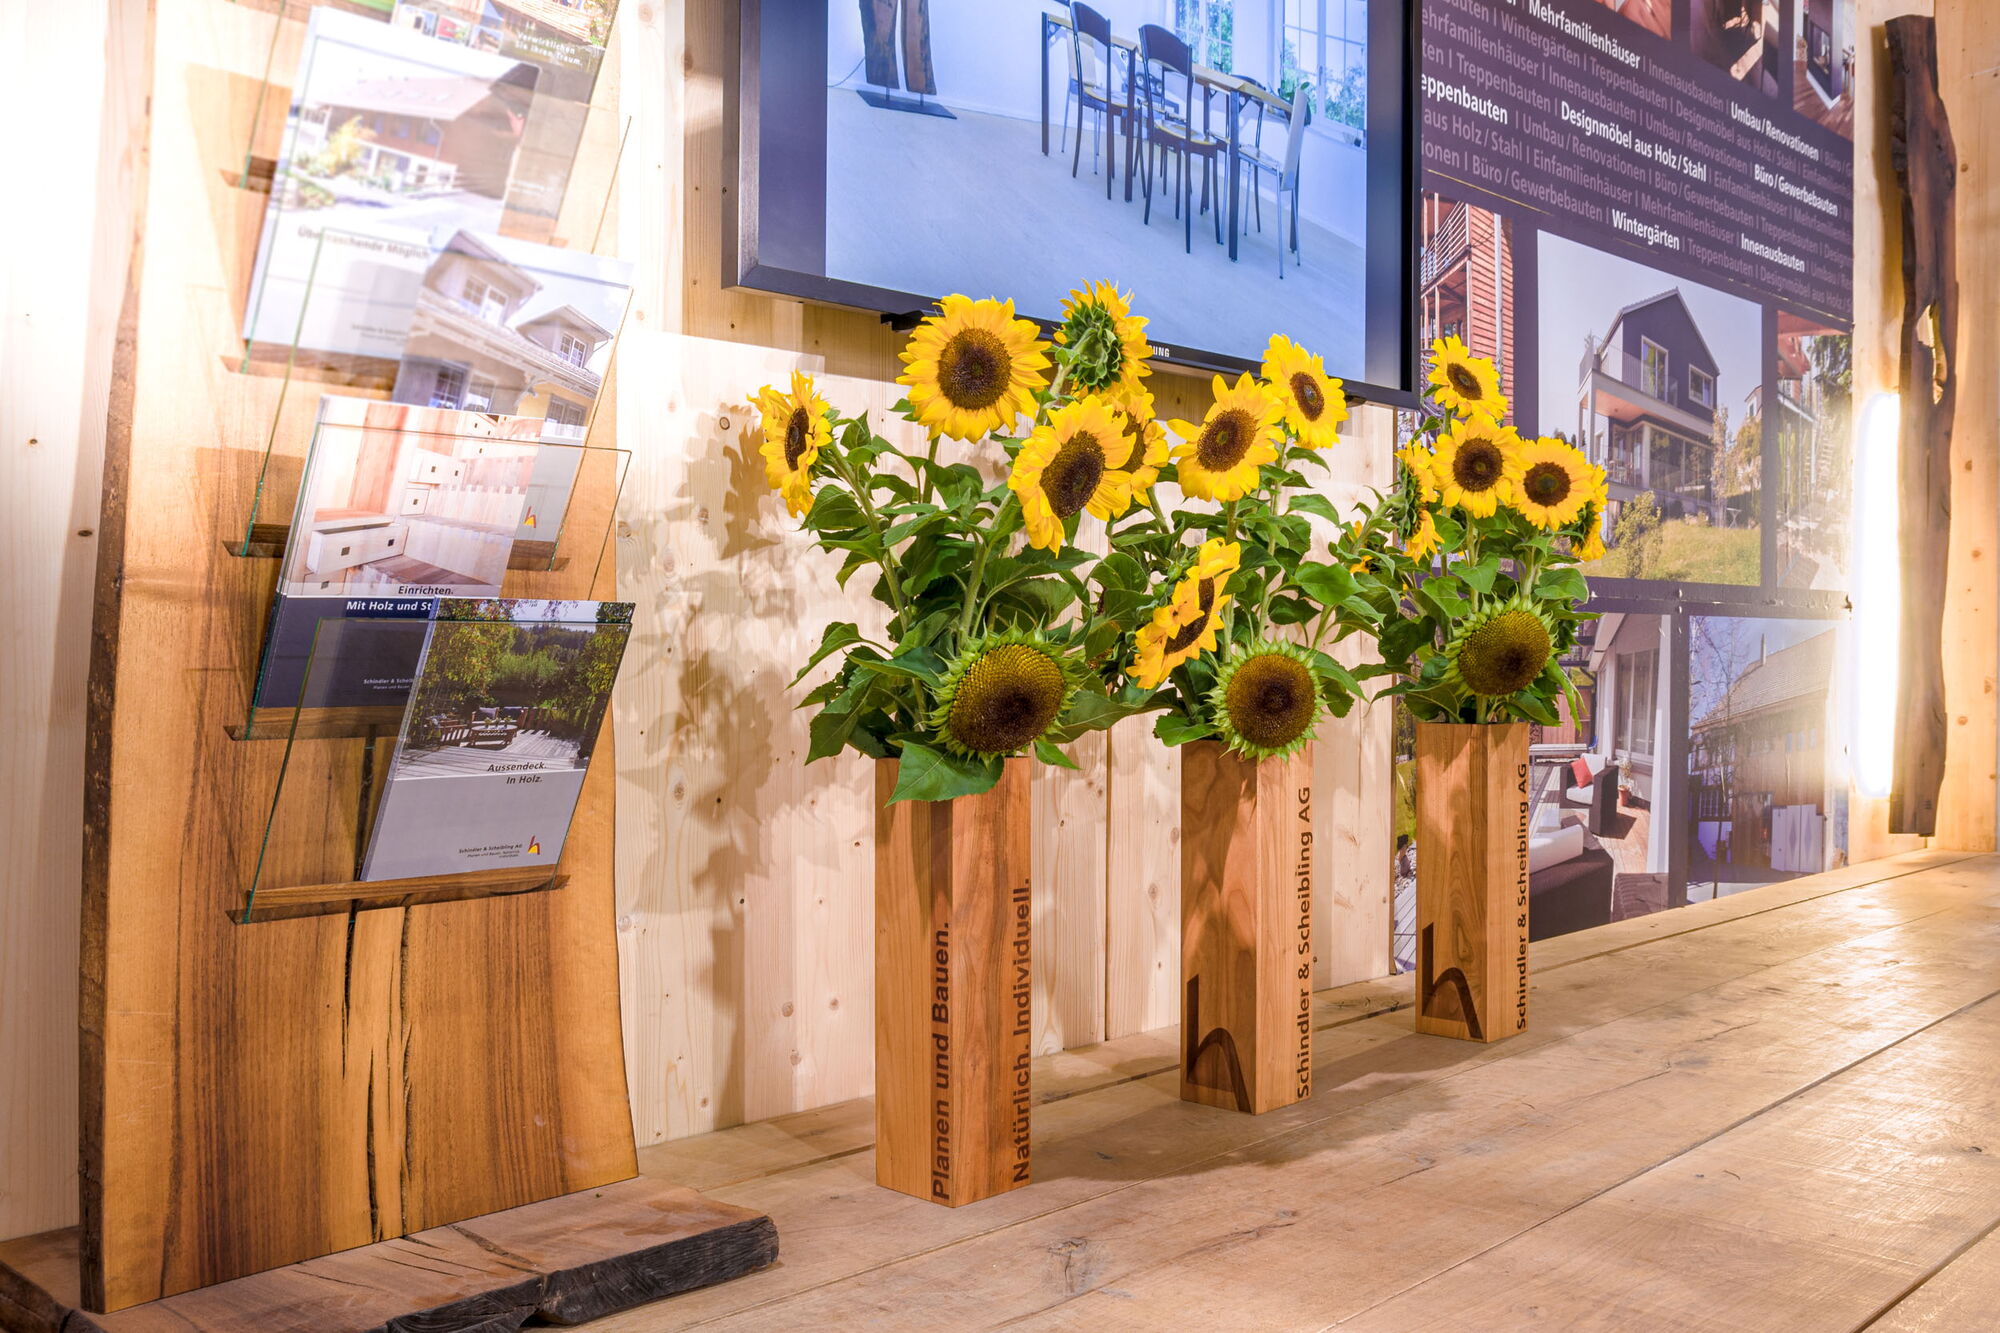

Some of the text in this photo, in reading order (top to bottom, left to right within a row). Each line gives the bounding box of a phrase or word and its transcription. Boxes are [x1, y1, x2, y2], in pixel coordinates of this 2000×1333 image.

[517, 31, 576, 55] Verwirklichen
[1422, 5, 1539, 77] ehrfamilienhäuser
[1549, 65, 1637, 124] Innenausbauten
[1500, 10, 1580, 68] Wintergärten
[1590, 56, 1668, 111] Treppenbauten
[1676, 99, 1735, 143] Designmöbel
[1737, 133, 1751, 151] aus
[1528, 0, 1640, 69] Mehrfamilienhäuser
[1649, 58, 1724, 112] Innenausbauten
[1421, 73, 1508, 125] eppenbauten
[1761, 215, 1818, 254] Treppenbauten
[1424, 108, 1448, 132] aus
[1534, 148, 1632, 205] Einfamilienhäuser
[1641, 192, 1735, 244] Mehrfamilienhäuser
[1741, 232, 1805, 273] Innenausbauten
[1456, 51, 1551, 113] Treppenbauten
[1561, 100, 1632, 149] Designmöbel
[1635, 138, 1652, 158] aus
[1714, 171, 1788, 217] Einfamilienhäuser
[297, 226, 429, 259] Überaschende Möglich
[1421, 133, 1460, 168] ionen
[1612, 208, 1680, 251] Wintergärten
[1688, 238, 1753, 278] Treppenbauten
[1761, 265, 1811, 299] Designmöbel
[346, 600, 432, 611] Mit Holz und St
[398, 585, 454, 595] Einrichten.
[487, 761, 547, 772] Aussendeck.
[506, 774, 543, 785] In Holz.
[1294, 786, 1313, 1100] Schindler & Scheibling AG
[1516, 763, 1529, 1030] Schindler & Scheibling AG
[931, 921, 950, 1201] Planen und Bauen.
[1012, 877, 1030, 1184] Natürlich. Individuell.
